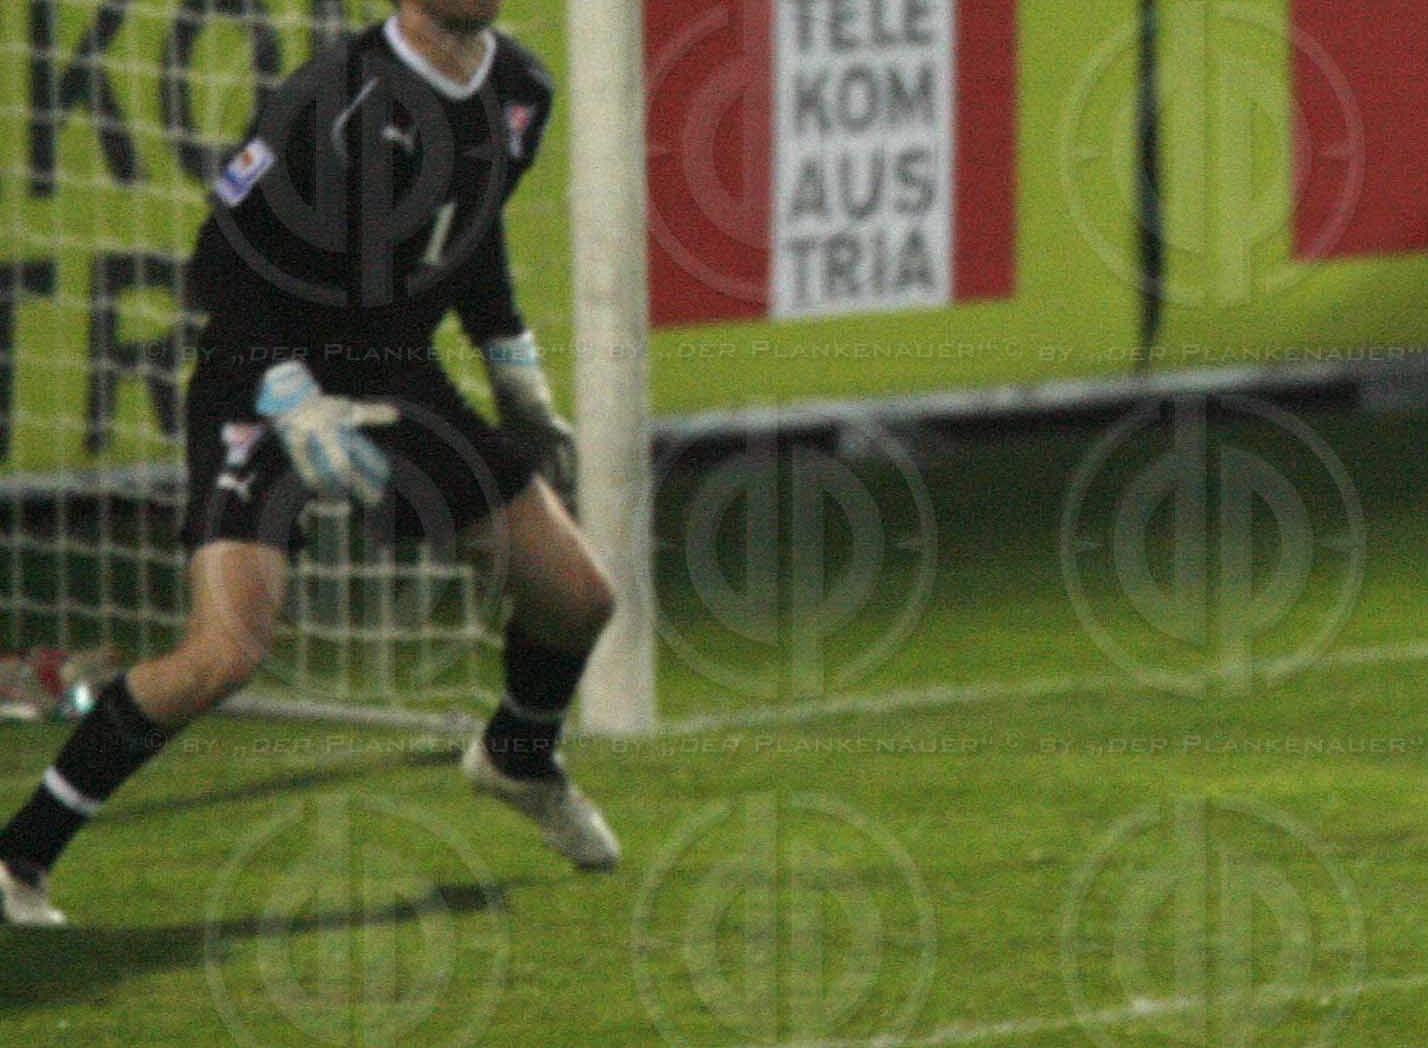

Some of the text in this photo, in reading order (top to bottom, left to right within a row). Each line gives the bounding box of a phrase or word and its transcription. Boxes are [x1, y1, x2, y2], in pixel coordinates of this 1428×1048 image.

[792, 63, 933, 133] KOM
[788, 149, 936, 221] AUS
[423, 201, 455, 267] 1
[787, 229, 934, 307] TRIA
